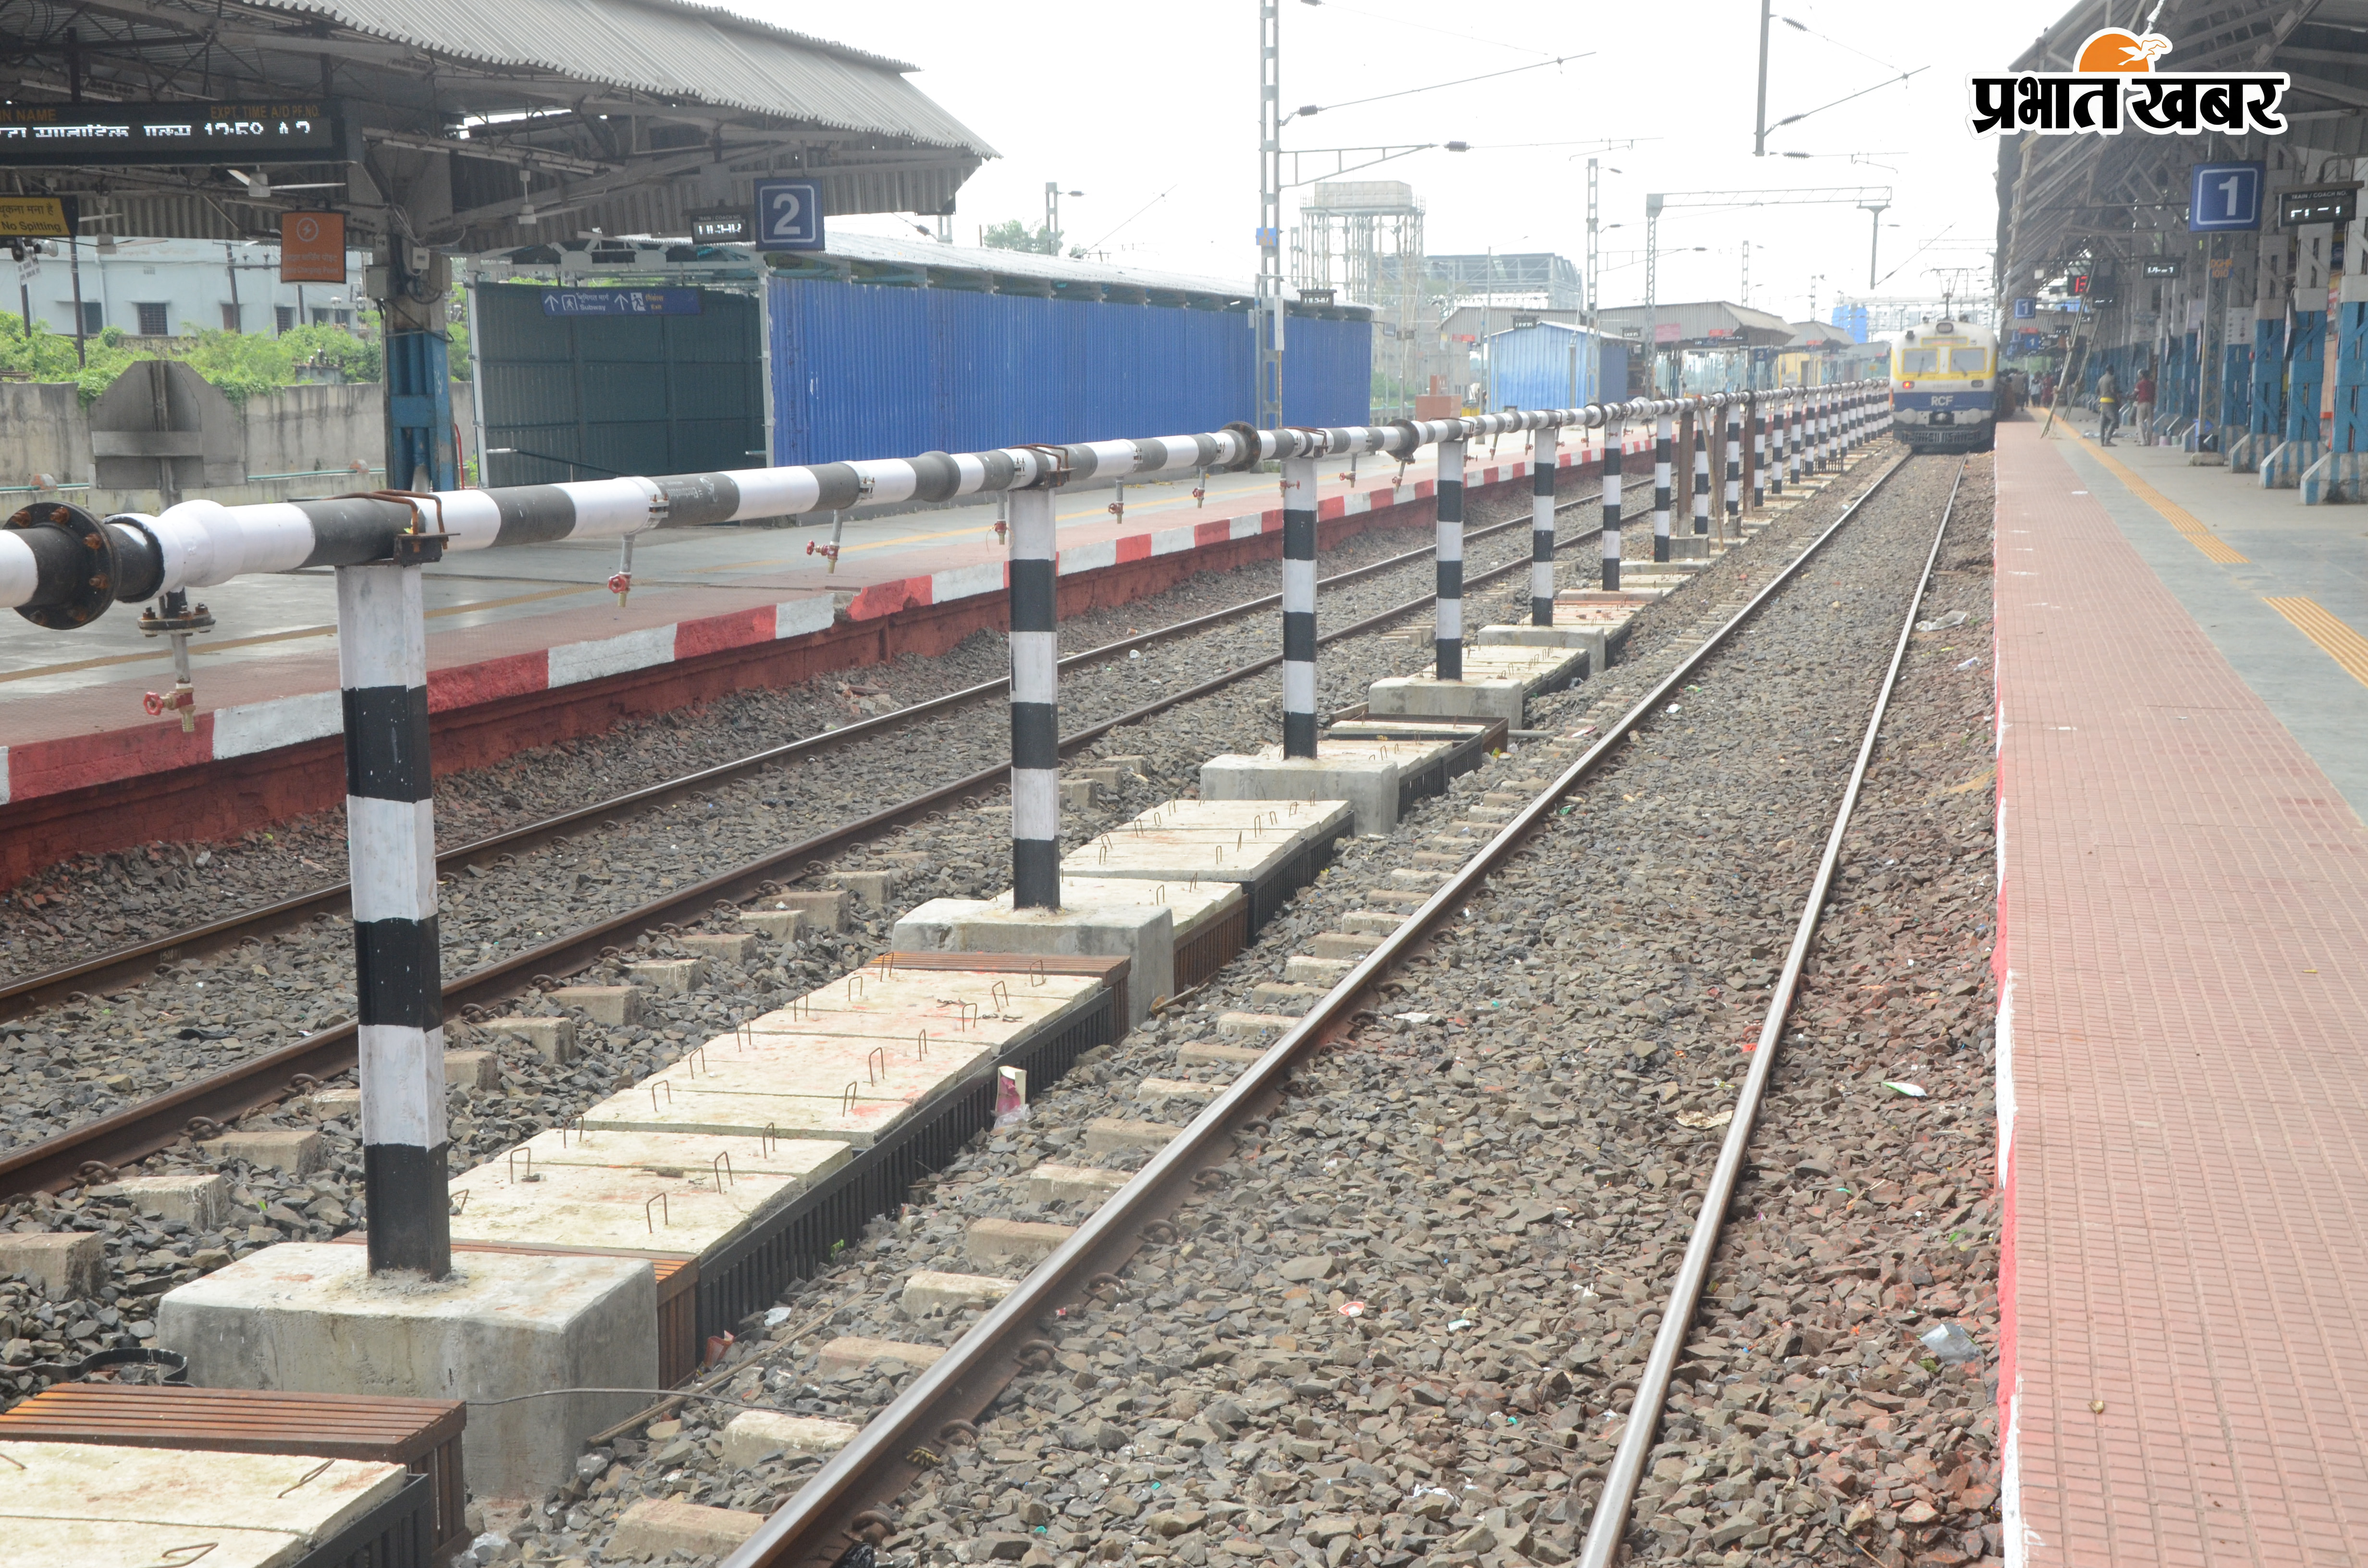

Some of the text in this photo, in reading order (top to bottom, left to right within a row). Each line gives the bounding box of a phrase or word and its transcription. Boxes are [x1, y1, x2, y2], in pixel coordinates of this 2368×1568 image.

[17, 109, 57, 121] NAME
[242, 106, 267, 118] TIME
[271, 106, 288, 117] A/D
[2218, 176, 2238, 216] 1
[27, 206, 44, 214] मना
[47, 202, 53, 215] है
[773, 194, 801, 235] 2
[1, 221, 62, 233] No Spitting
[2022, 301, 2029, 315] 1
[2030, 337, 2035, 346] 1
[1931, 395, 1953, 406] RCF
